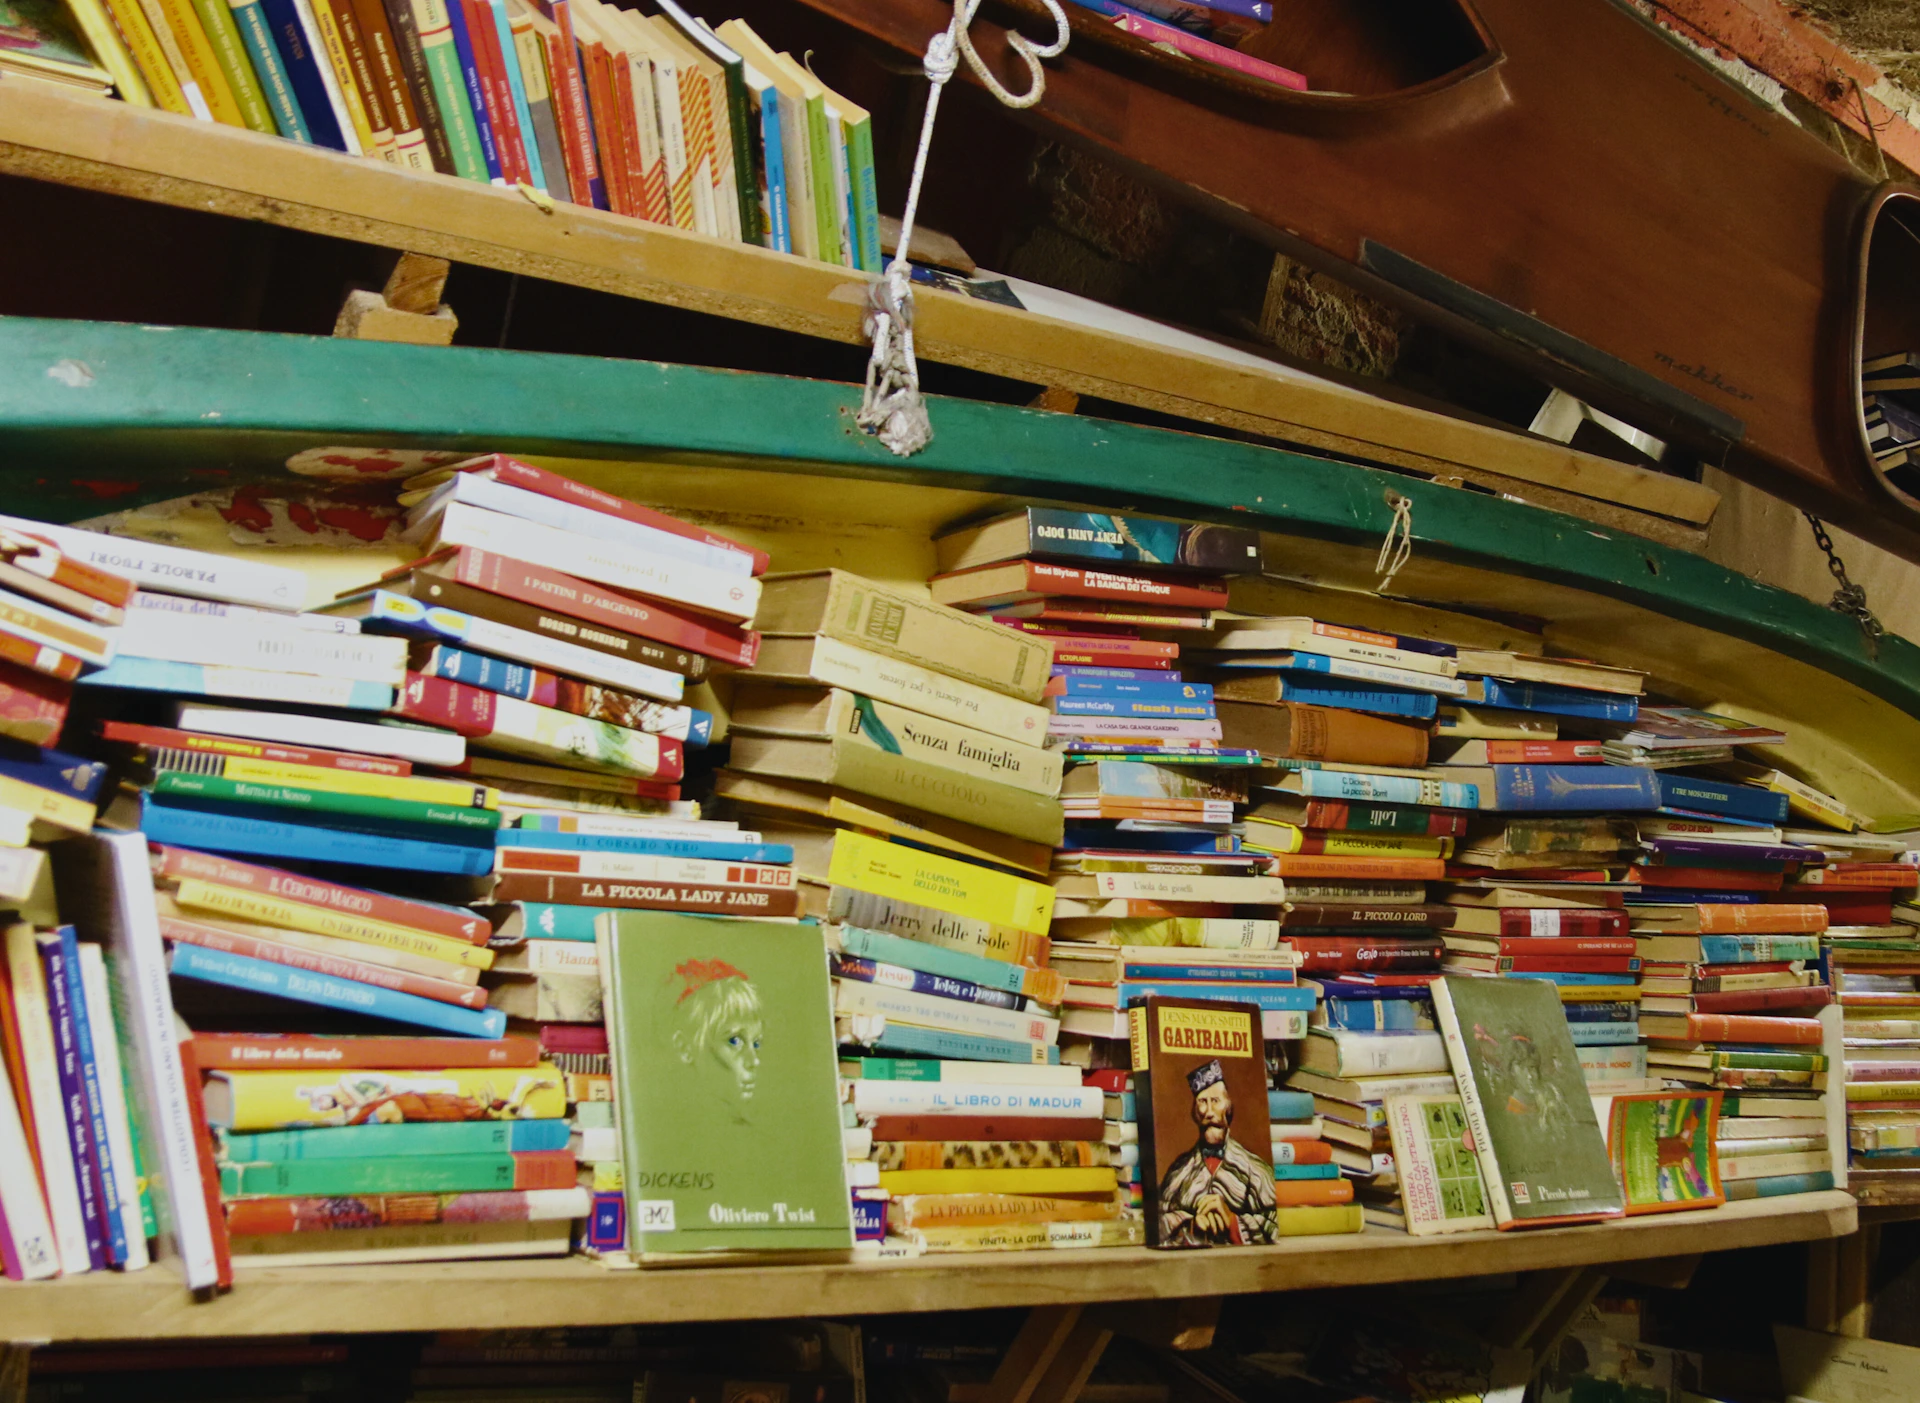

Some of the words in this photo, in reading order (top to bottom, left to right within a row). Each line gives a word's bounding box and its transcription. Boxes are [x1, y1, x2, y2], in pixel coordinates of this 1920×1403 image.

[372, 31, 387, 53] Autori
[394, 103, 411, 130] MONDO
[566, 77, 585, 116] RITORNO
[576, 117, 587, 131] DEI
[577, 131, 597, 175] GUERRIERI
[1037, 526, 1065, 539] DOPO
[1068, 527, 1124, 544] VENT'ANNI
[89, 551, 143, 570] FUORI
[151, 562, 216, 584] PAROLE
[1035, 566, 1052, 575] Enid
[1053, 567, 1079, 578] Blyton
[1084, 579, 1096, 588] LA
[1097, 580, 1126, 590] BANDA
[1127, 583, 1140, 592] DEI
[1141, 584, 1170, 594] CINQUE
[140, 596, 184, 613] faccia
[190, 600, 228, 618] della
[532, 578, 577, 599] PATTINI
[582, 592, 648, 621] D'ARGENTO
[1074, 641, 1097, 649] VENDETTA
[1098, 642, 1113, 650] DEGLI
[1308, 658, 1316, 669] 28
[1337, 664, 1359, 674] MONDO
[879, 673, 906, 689] foreste
[1377, 670, 1399, 681] ANGOLO
[910, 682, 924, 693] per
[936, 690, 962, 705] deserti
[966, 701, 979, 712] Per
[1059, 700, 1085, 710] Maureen
[1086, 702, 1114, 712] McCarthy
[901, 723, 948, 751] Senza
[957, 739, 1021, 771] famiglia
[171, 777, 204, 791] Piumini
[911, 774, 988, 805] CUCCIOLO
[1349, 777, 1371, 787] Dickens
[1349, 788, 1370, 797] piccola
[1687, 789, 1728, 802] MOSCHETTIERI
[427, 808, 455, 822] Einaudi
[457, 811, 490, 825] Ragazzi
[1370, 810, 1397, 827] Lolli
[1667, 823, 1687, 832] GIRO
[1688, 824, 1696, 832] DI
[1697, 824, 1714, 833] BOA
[576, 837, 588, 847] IL
[597, 838, 655, 851] CORSARO
[665, 841, 699, 853] NERO
[1333, 838, 1341, 847] LA
[1342, 838, 1368, 848] PICCOLA
[1369, 839, 1387, 849] LADY
[1387, 840, 1403, 849] JANE
[915, 869, 925, 878] LA
[926, 871, 960, 888] CAPANNA
[281, 878, 328, 903] CERCHIO
[330, 889, 372, 913] MAGICO
[582, 883, 605, 897] LA
[609, 885, 676, 901] PICCOLA
[681, 889, 724, 905] LADY
[727, 892, 768, 906] JANE
[914, 878, 937, 891] DELLO
[952, 887, 967, 898] TOM
[1133, 881, 1155, 890] L'isola
[1158, 882, 1169, 891] dei
[1171, 884, 1193, 894] gioielli
[1352, 911, 1362, 921] IL
[1363, 911, 1401, 921] PICCOLO
[1403, 912, 1428, 922] LORD
[880, 905, 923, 938] Jerry
[932, 917, 969, 942] delle
[976, 928, 1010, 951] isole
[876, 1000, 912, 1014] CERVINO
[914, 1005, 931, 1016] DEL
[933, 1009, 961, 1021] FIGLIO
[1163, 1012, 1190, 1023] DENIS
[1192, 1013, 1217, 1026] MACK
[1219, 1015, 1247, 1028] SMITH
[1130, 1011, 1142, 1069] GARIBALDI
[1164, 1027, 1248, 1051] GARIBALDI
[244, 1048, 272, 1059] Libro
[274, 1048, 301, 1059] della
[303, 1048, 343, 1061] Giungla
[1596, 1061, 1607, 1069] DEL
[933, 1094, 947, 1106] IL
[954, 1095, 1001, 1107] LIBRO
[1008, 1096, 1022, 1108] DI
[1029, 1097, 1082, 1108] MADUR
[85, 1079, 101, 1115] piccola
[93, 1118, 106, 1142] casa
[639, 1172, 714, 1190] DICKENS
[1407, 1172, 1421, 1223] TIMBRA
[1537, 1185, 1567, 1201] Piccole
[1569, 1187, 1590, 1199] donne
[708, 1202, 769, 1223] Oliviero
[772, 1202, 816, 1223] Twist
[930, 1206, 944, 1219] LA
[948, 1204, 994, 1218] PICCOLA
[999, 1202, 1028, 1218] LADY
[1030, 1200, 1058, 1213] JANE
[979, 1236, 1006, 1246] VINETA
[1013, 1236, 1024, 1244] LA
[1050, 1232, 1092, 1242] SOMMERSA
